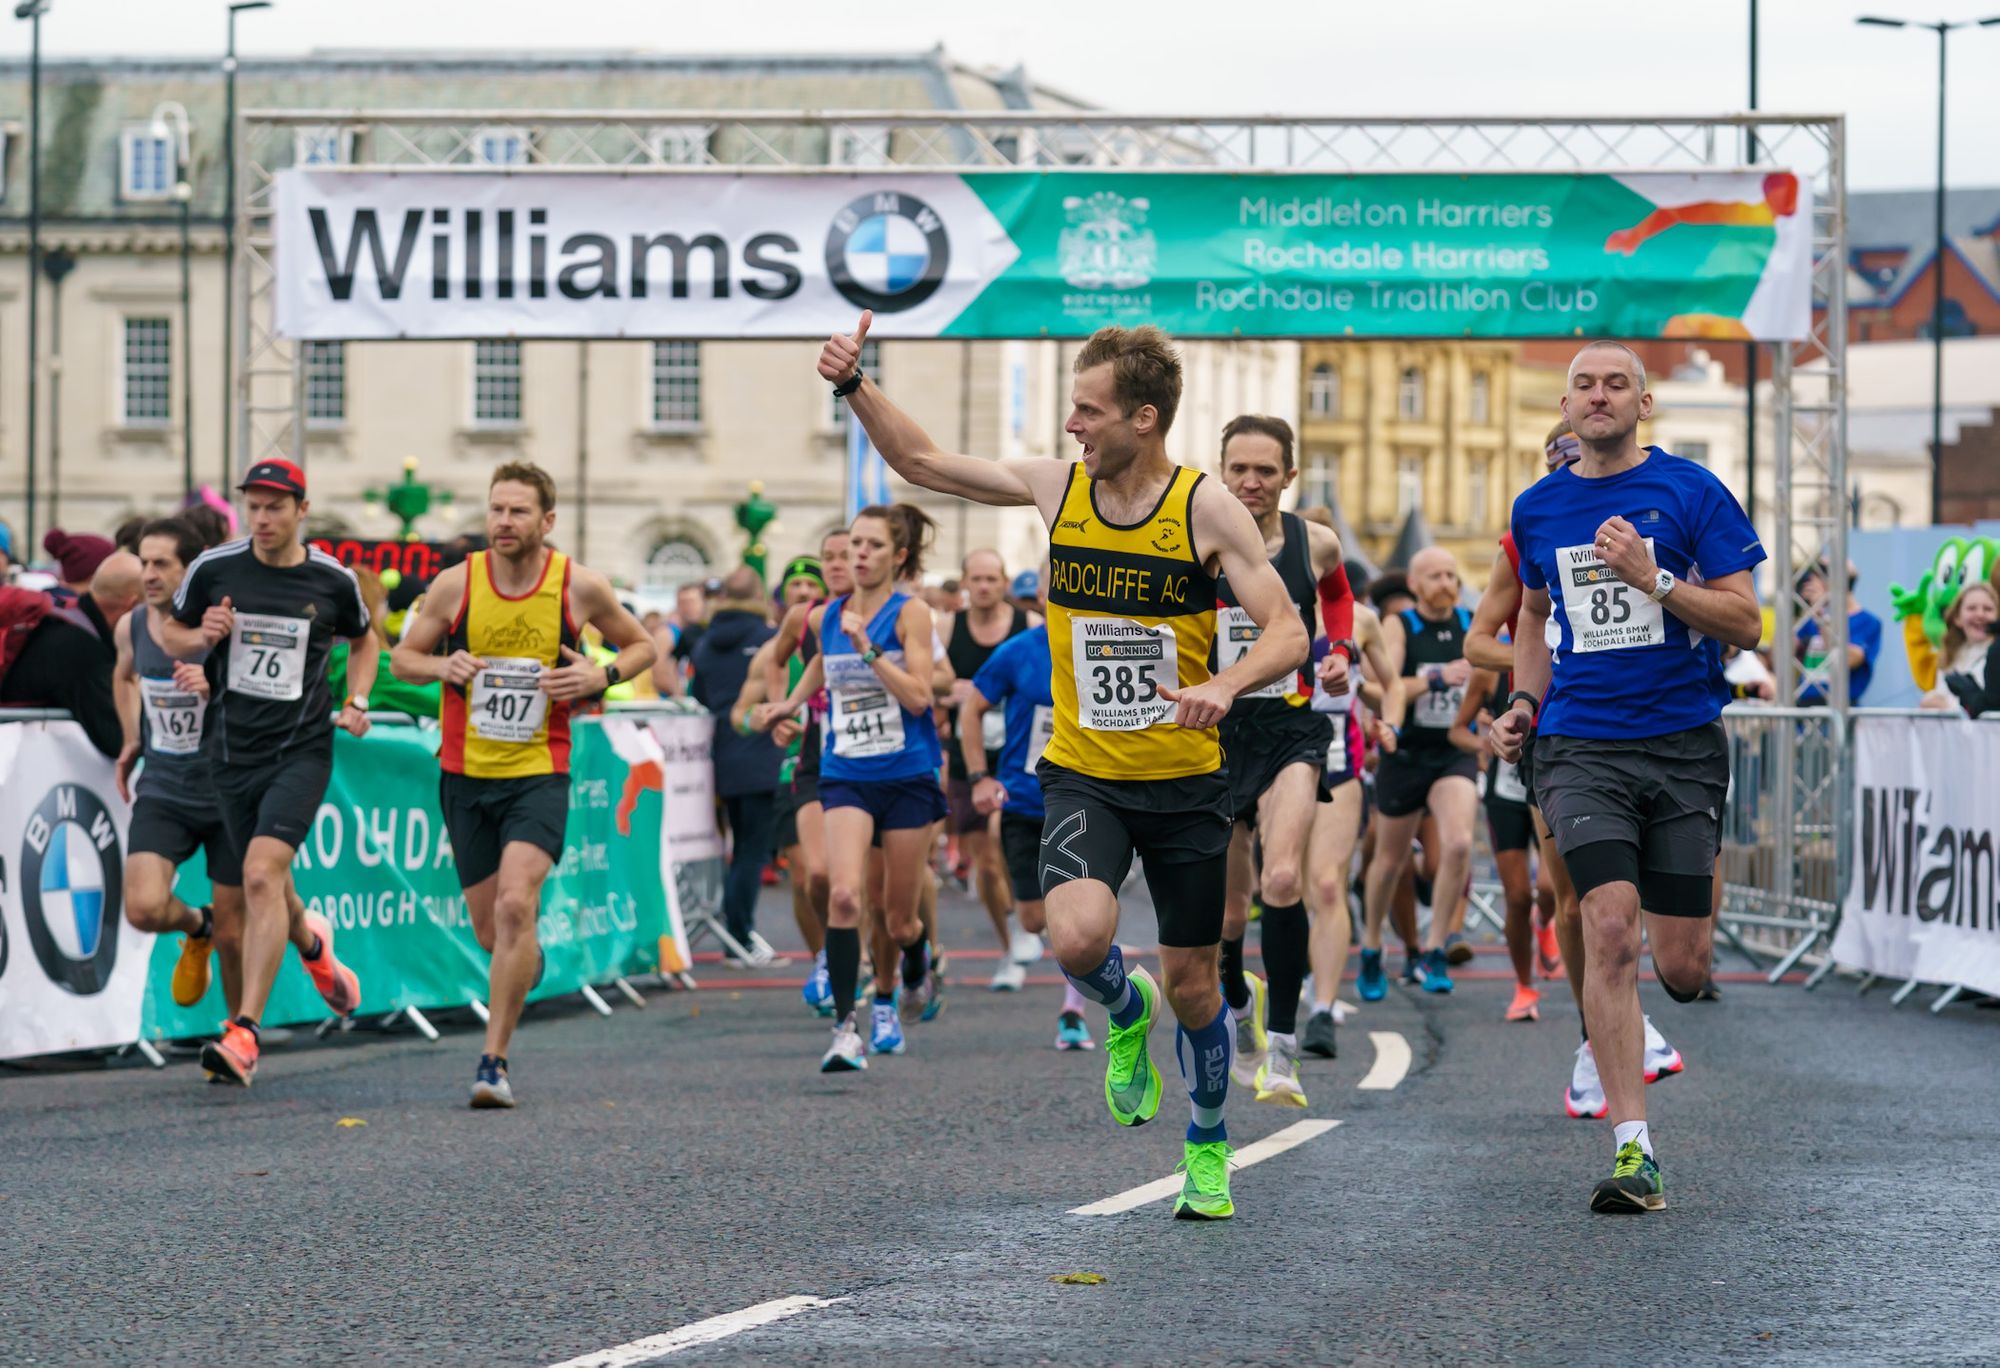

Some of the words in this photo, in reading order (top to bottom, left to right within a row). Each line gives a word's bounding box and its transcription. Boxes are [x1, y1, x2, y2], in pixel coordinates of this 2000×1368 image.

[1240, 197, 1407, 227] Middleton
[1417, 198, 1553, 228] Harriers
[308, 208, 802, 301] Williams
[1244, 239, 1404, 271] Rochdale
[1412, 240, 1550, 271] Harriers
[1196, 280, 1354, 312] Rochdale
[1367, 280, 1511, 312] Triathlon
[1521, 281, 1599, 312] Club
[1052, 558, 1152, 602] RADCLIFFE
[1160, 574, 1190, 604] AC
[1590, 586, 1631, 626] 85
[1085, 623, 1143, 636] Williams
[1582, 627, 1624, 640] WILLIAMS
[1626, 624, 1651, 634] BMW
[1629, 633, 1653, 645] HALF
[250, 649, 281, 679] 76
[1092, 664, 1158, 705] 385
[158, 710, 199, 736] 162
[485, 693, 534, 723] 407
[1091, 708, 1138, 718] WILLIAMS
[1140, 704, 1166, 716] BMW
[1091, 717, 1141, 727] ROCHDALE
[846, 713, 885, 741] 441
[25, 786, 116, 856] BMW
